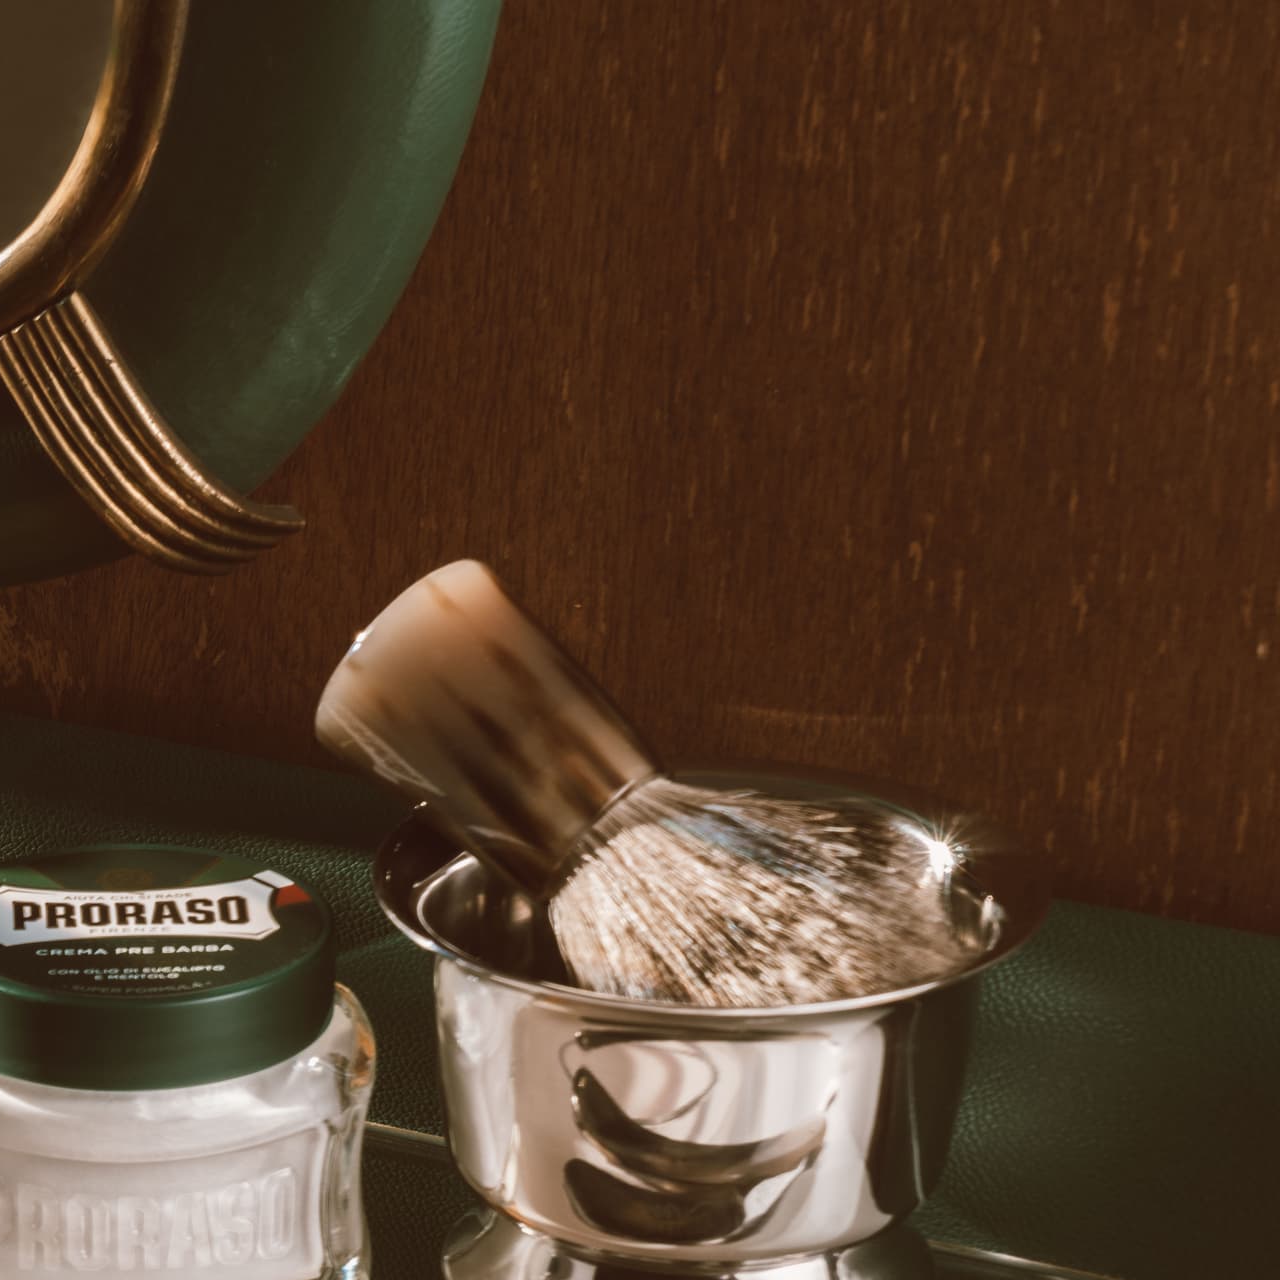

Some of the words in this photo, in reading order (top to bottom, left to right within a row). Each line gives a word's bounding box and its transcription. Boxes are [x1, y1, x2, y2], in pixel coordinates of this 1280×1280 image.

[13, 896, 250, 930] PRORASO
[35, 947, 109, 956] CREMA
[114, 946, 156, 955] PRE
[161, 943, 236, 954] BARBA
